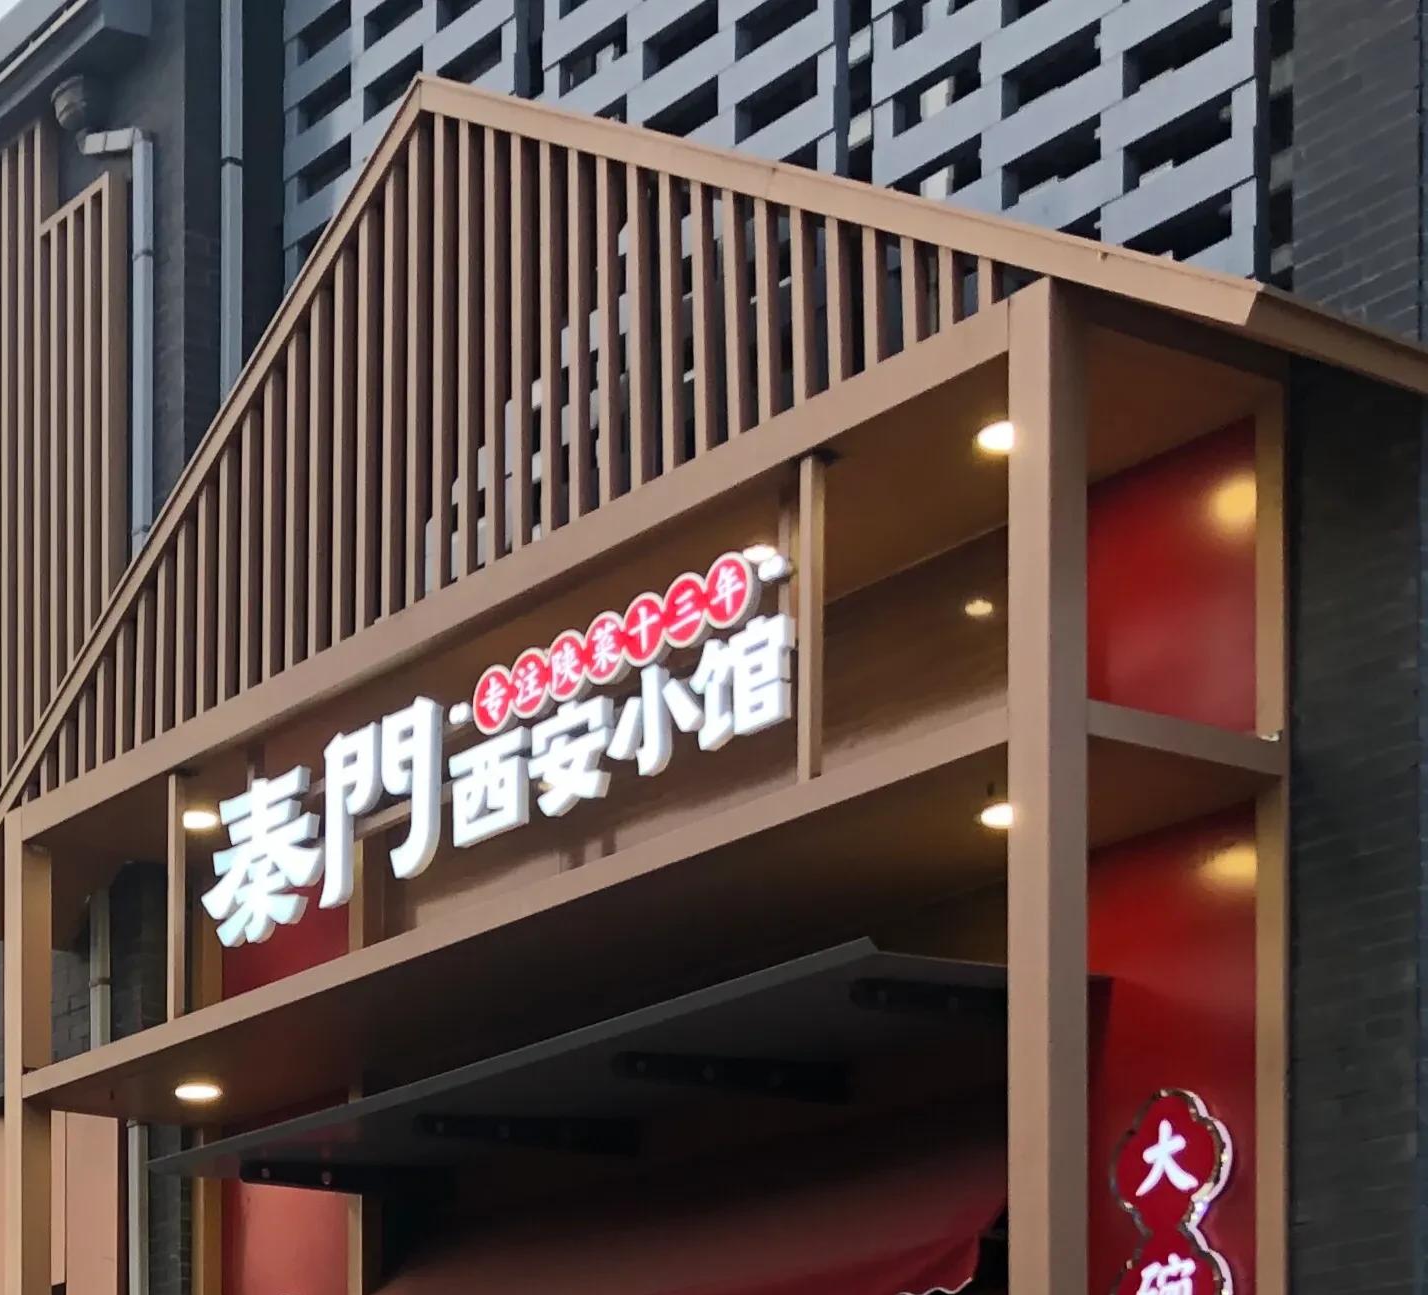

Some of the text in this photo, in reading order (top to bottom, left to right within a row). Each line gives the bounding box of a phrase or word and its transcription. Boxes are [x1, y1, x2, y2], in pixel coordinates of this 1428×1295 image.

[478, 564, 746, 724] 专注陕菜十三年
